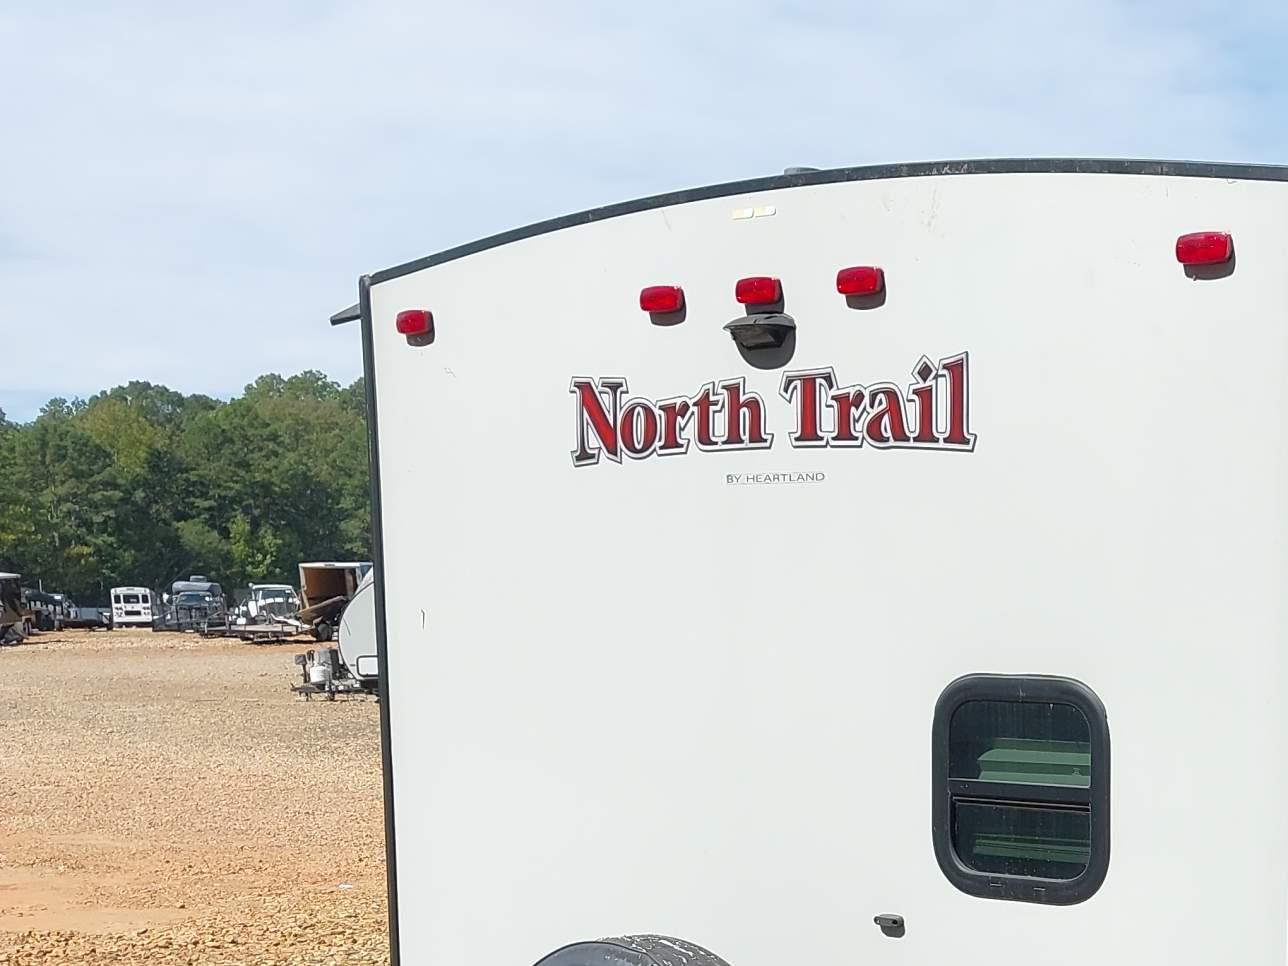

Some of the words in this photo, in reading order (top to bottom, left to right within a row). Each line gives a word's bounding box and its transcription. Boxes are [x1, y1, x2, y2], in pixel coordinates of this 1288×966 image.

[569, 376, 775, 467] North
[779, 351, 977, 453] Trail
[726, 474, 742, 484] BY
[746, 472, 825, 483] HEARTLAND
